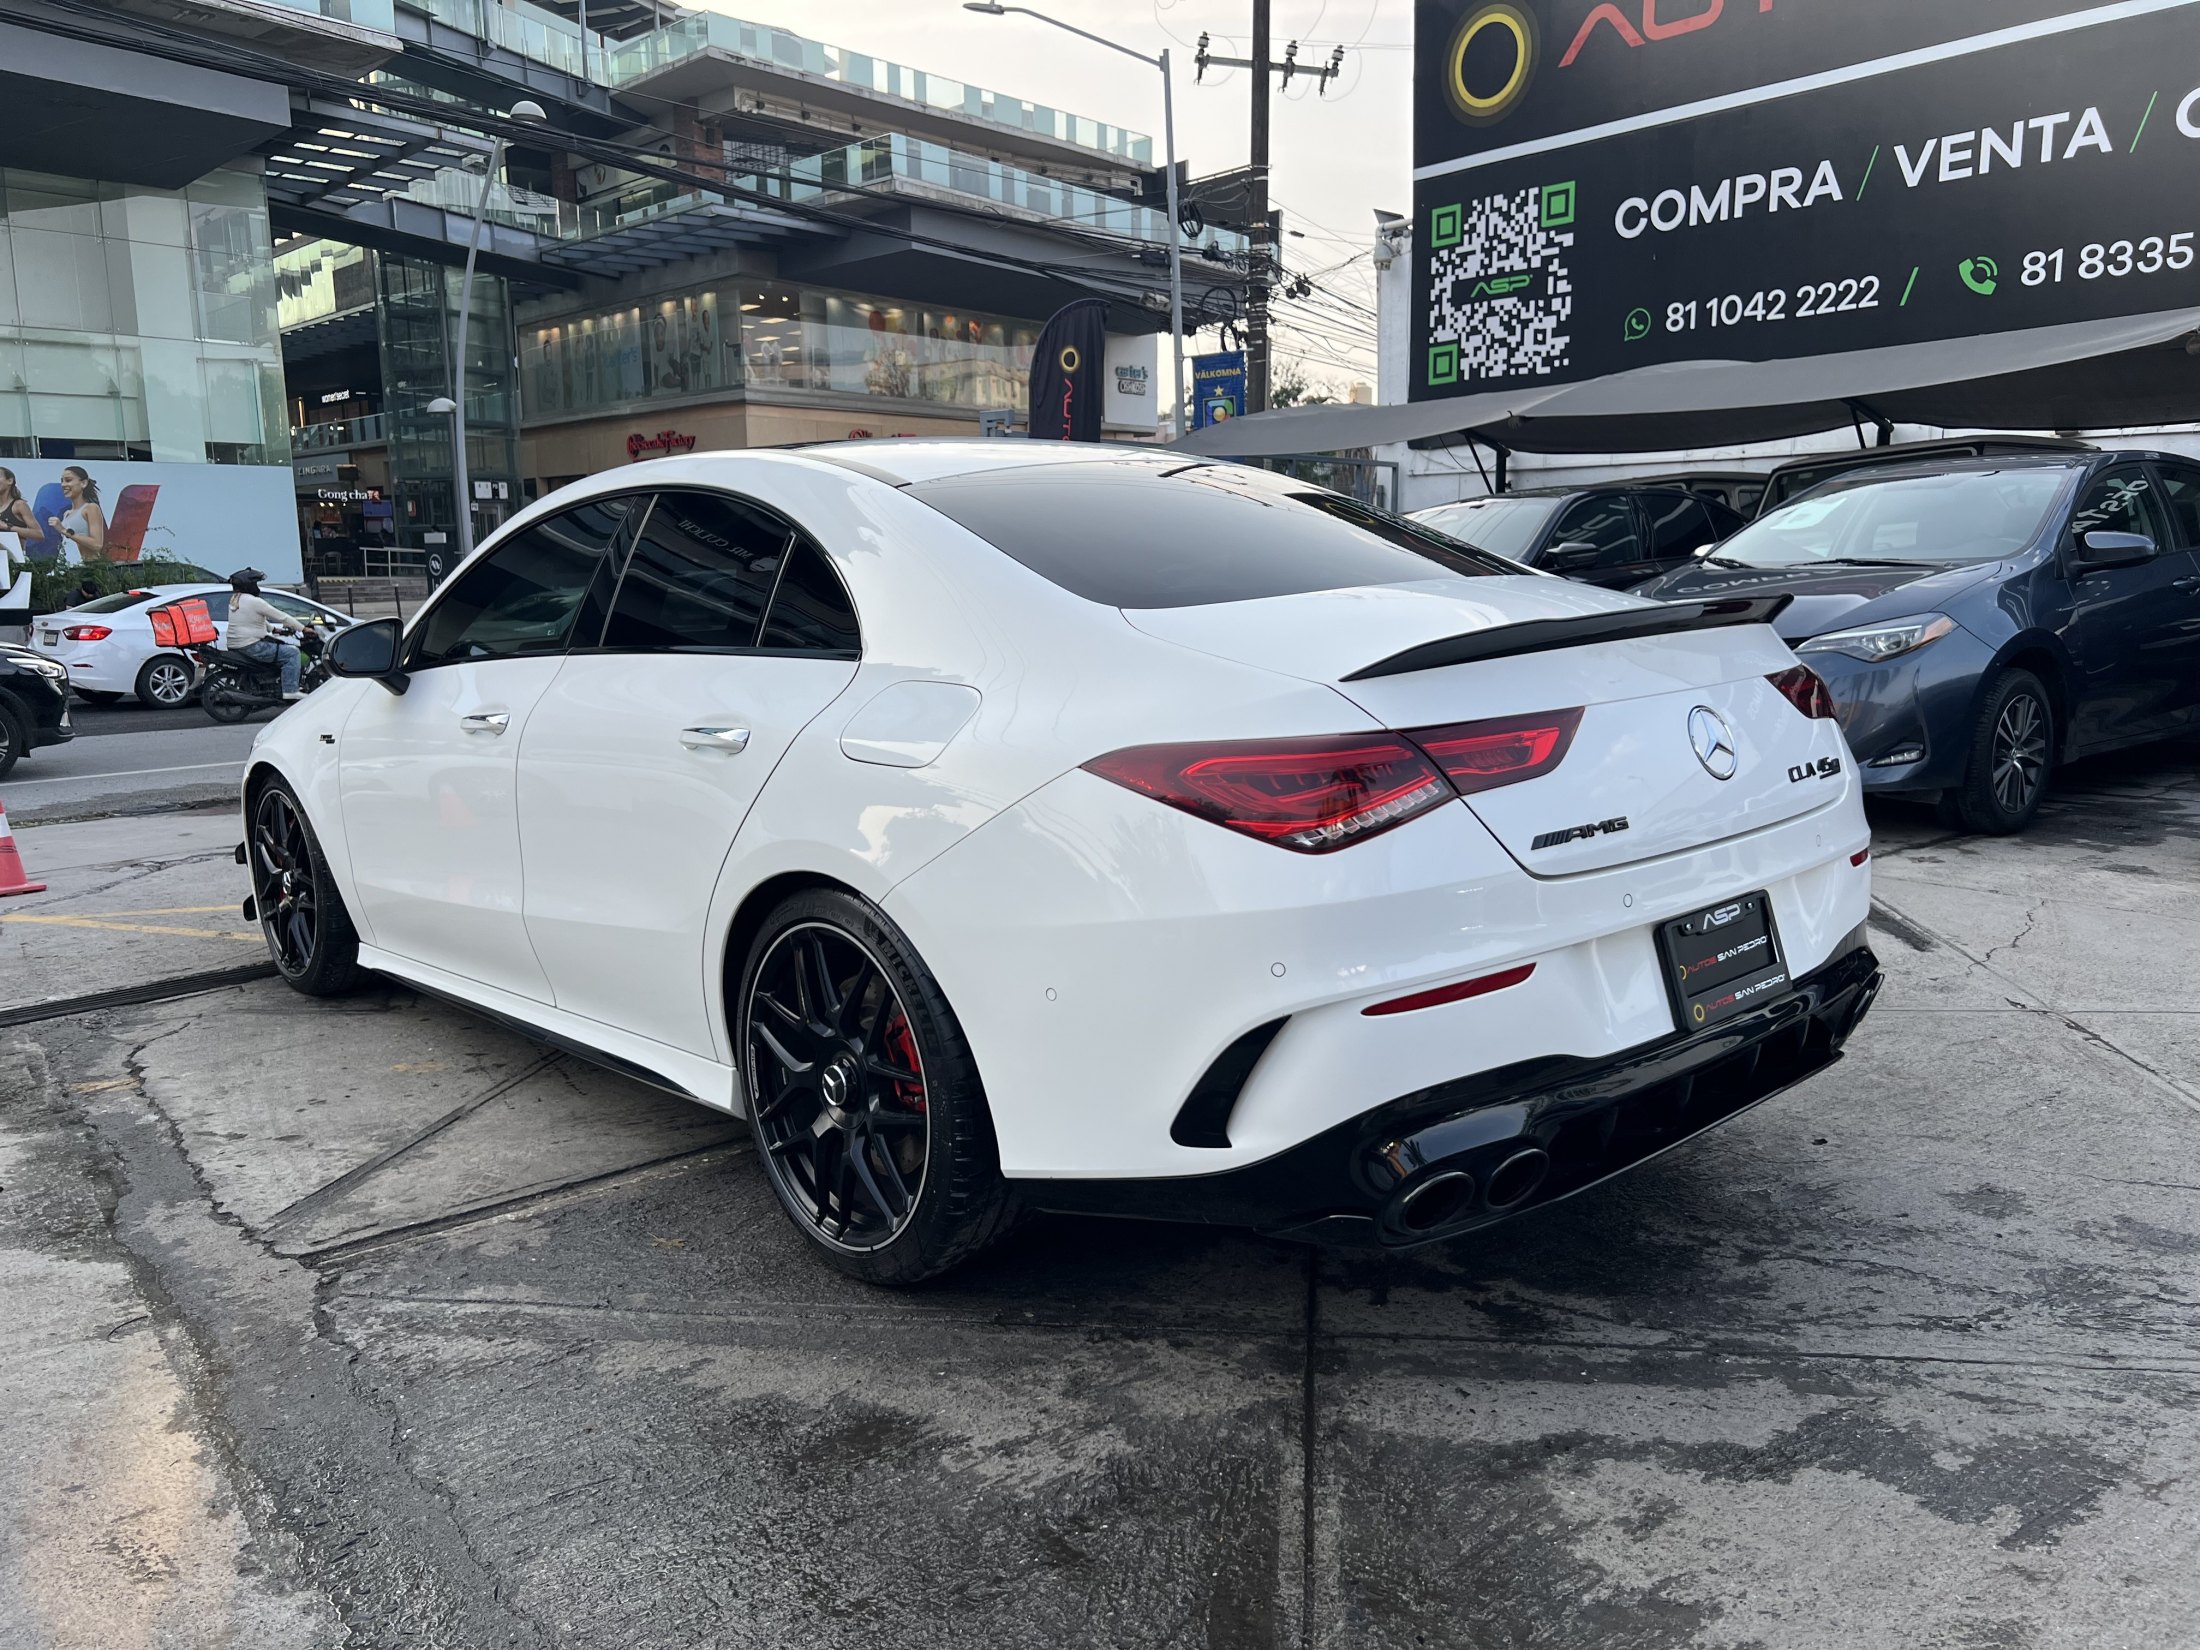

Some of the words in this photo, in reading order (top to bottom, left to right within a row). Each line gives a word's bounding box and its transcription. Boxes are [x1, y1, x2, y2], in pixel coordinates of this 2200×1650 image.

[1614, 160, 1843, 239] COMPRA
[1894, 106, 2113, 189] VENTA
[1665, 302, 1697, 333] 81
[1705, 287, 1787, 327] 1042
[1795, 274, 1881, 317] 2222
[2020, 248, 2065, 287] 81
[2078, 231, 2195, 280] 8335
[1194, 367, 1242, 380] VÄLKOMNA
[317, 488, 348, 502] Gong
[348, 488, 368, 500] cha
[1788, 761, 1817, 783] CLA
[1702, 902, 1742, 930] ASP
[1686, 955, 1718, 975] AUTOS
[1717, 947, 1738, 962] SAN
[1737, 934, 1769, 954] PEDRO
[1705, 993, 1735, 1012] AUTOS
[1734, 986, 1755, 1001] SAN
[1755, 974, 1786, 993] PEDRO
